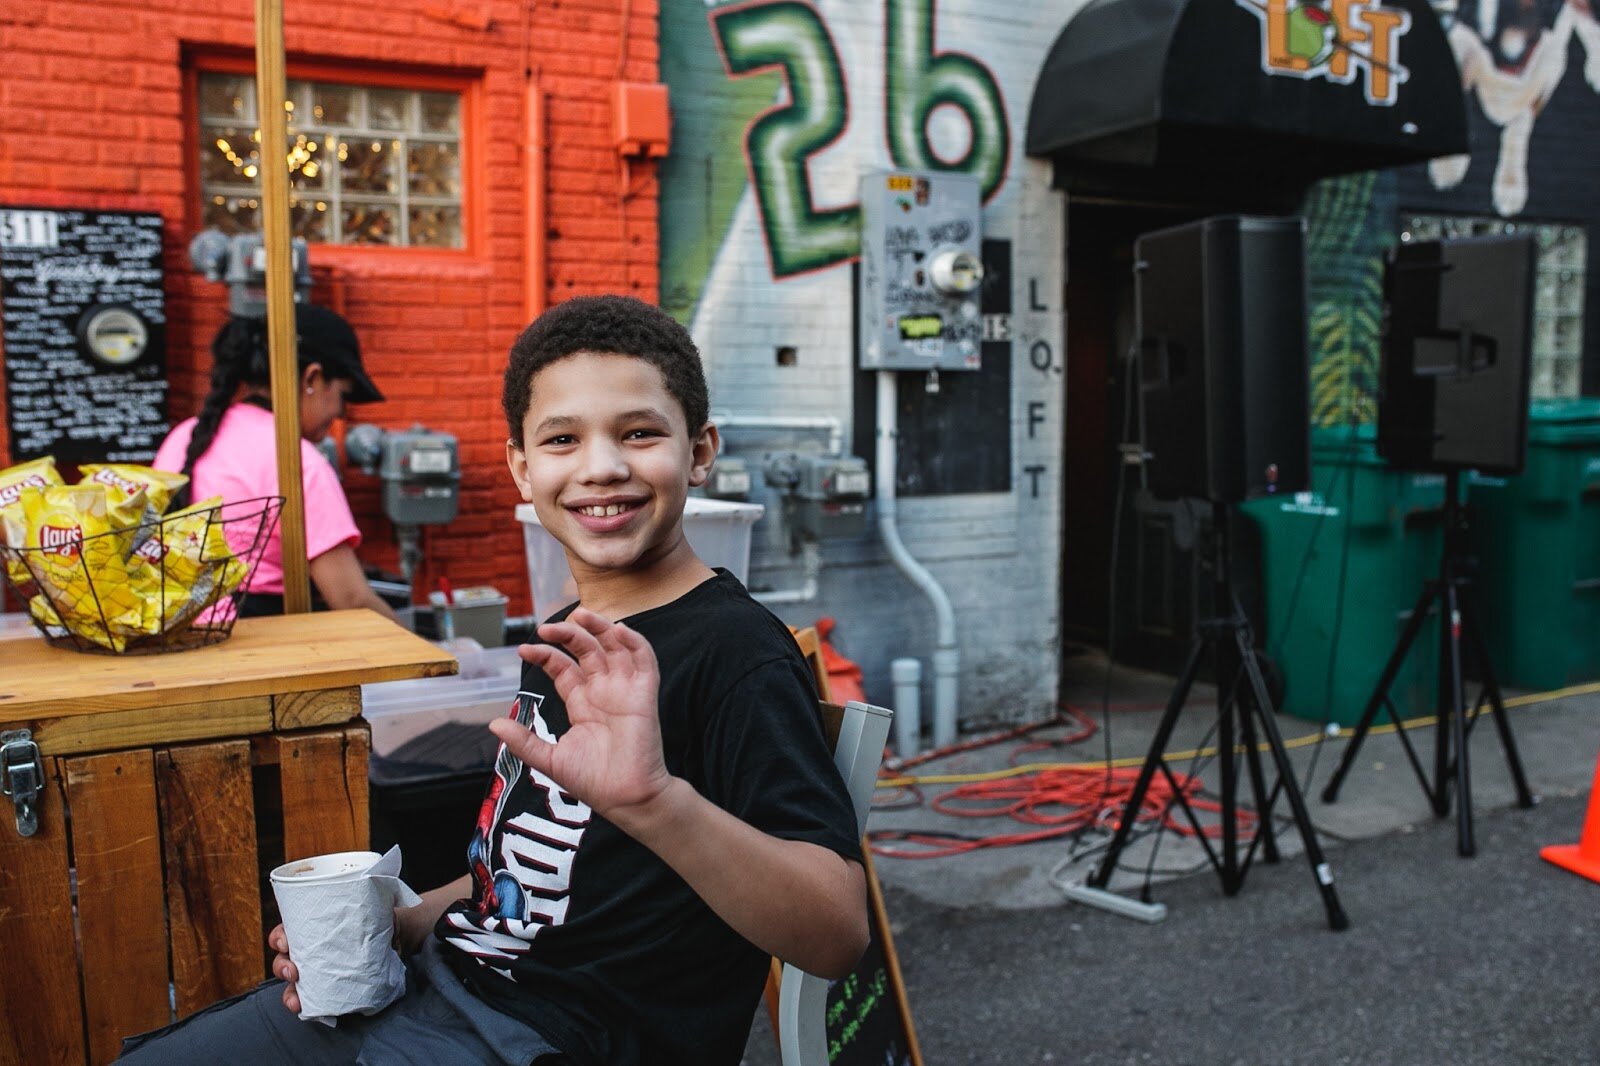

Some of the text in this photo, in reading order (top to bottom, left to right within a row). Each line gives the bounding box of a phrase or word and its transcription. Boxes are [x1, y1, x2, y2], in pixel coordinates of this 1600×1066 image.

[708, 0, 1010, 283] 26
[1024, 279, 1052, 498] LOFT
[43, 526, 81, 556] Lay's
